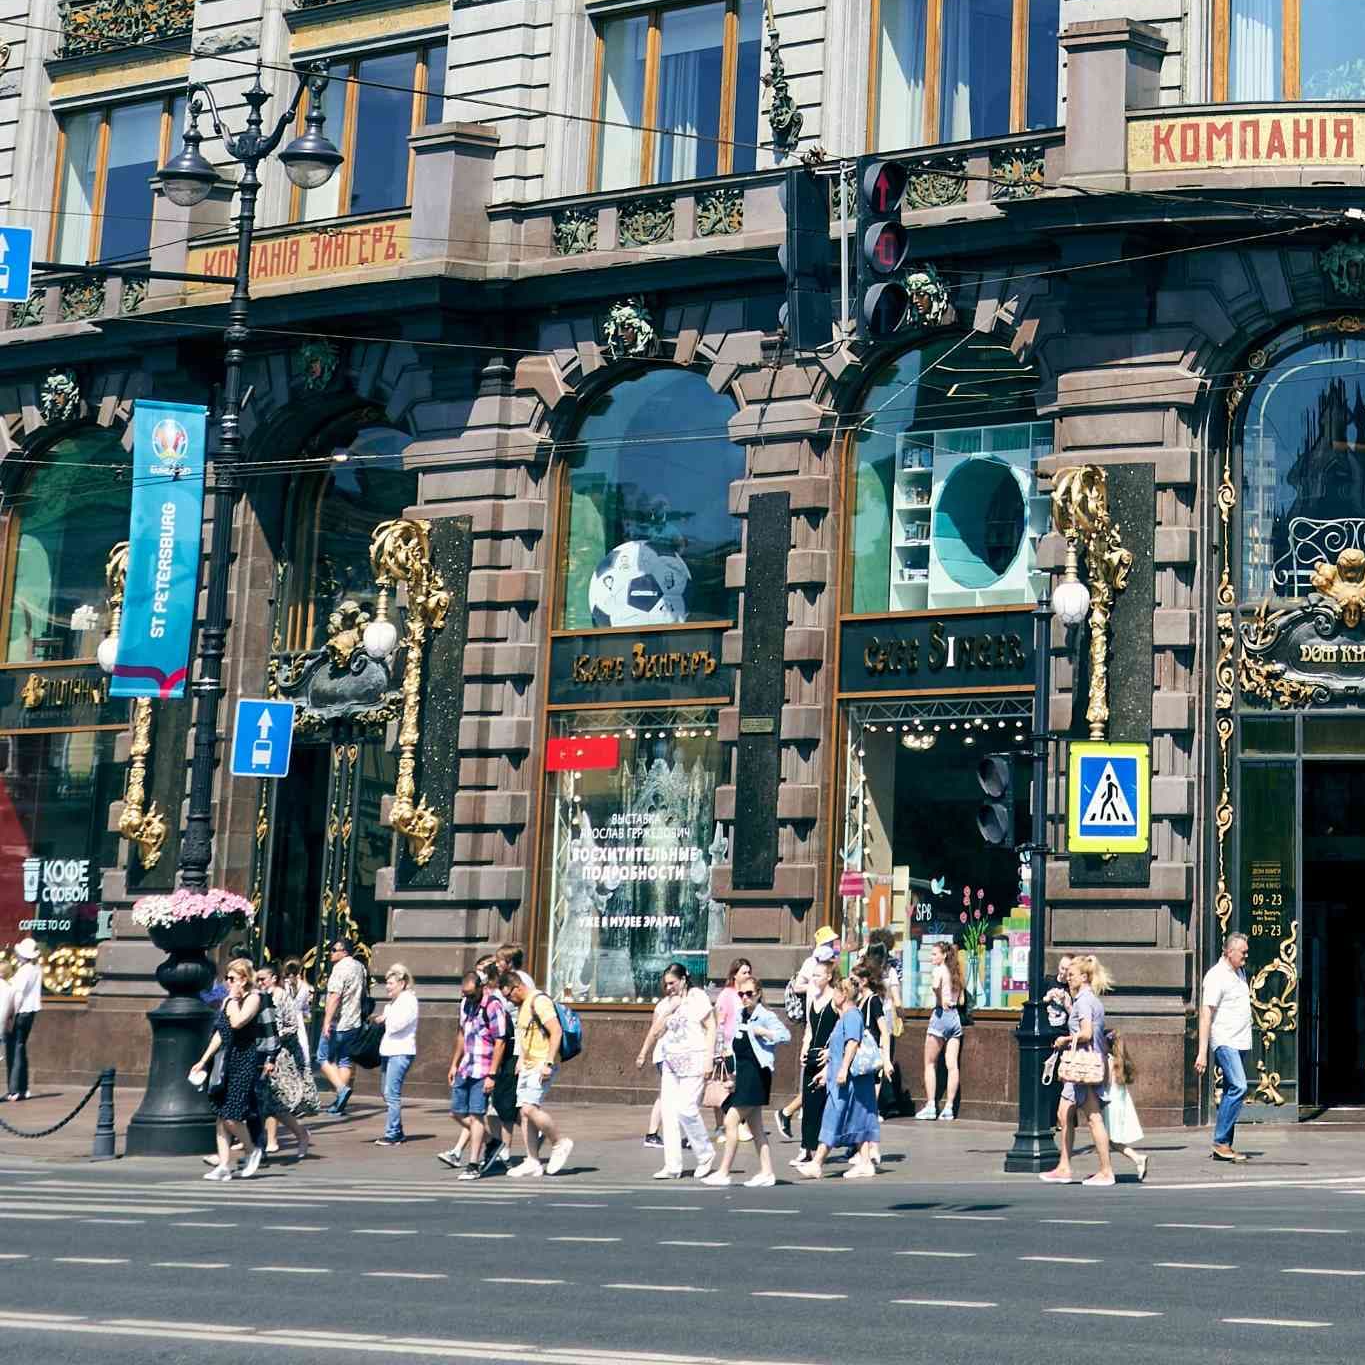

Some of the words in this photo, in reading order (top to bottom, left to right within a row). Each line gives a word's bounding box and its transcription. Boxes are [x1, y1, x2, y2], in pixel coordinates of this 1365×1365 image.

[1152, 118, 1354, 163] КОМПАНІЯ
[153, 501, 177, 612] PETERSBURG
[151, 613, 166, 638] ST
[1299, 644, 1338, 663] ДОМ
[573, 846, 698, 862] ВОСХИТИТЕЛЬНЫЕ
[43, 860, 89, 883] КОФЕ
[582, 866, 685, 881] ПОДРОБНОСТИ
[1252, 894, 1264, 906] 09
[1271, 894, 1282, 906] 23
[59, 920, 71, 930] GO
[643, 915, 681, 928] ЭРАРТА
[1251, 924, 1263, 936] 09
[1271, 924, 1281, 936] 23
